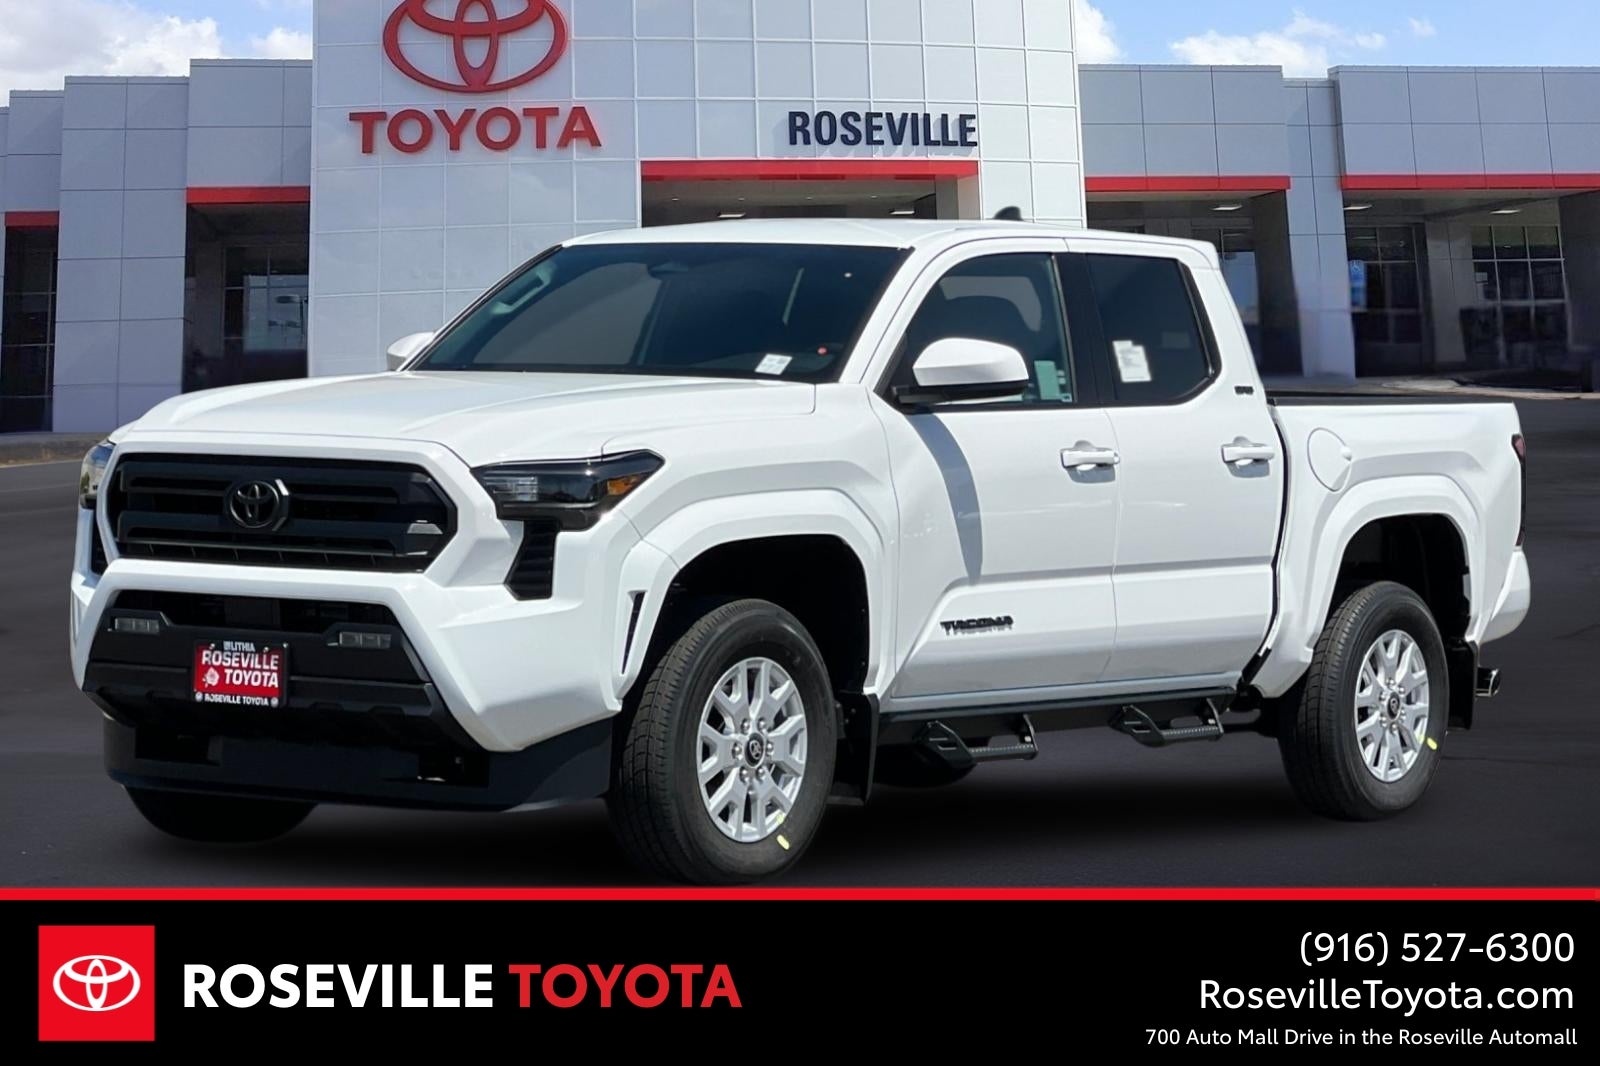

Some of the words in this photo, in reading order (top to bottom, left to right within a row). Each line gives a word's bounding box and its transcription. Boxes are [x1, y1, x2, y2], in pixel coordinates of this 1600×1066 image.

[350, 106, 601, 154] TOYOTA
[788, 111, 978, 147] ROSEVILLE
[230, 641, 256, 652] LITHIA
[202, 650, 279, 669] ROSEVILLE
[224, 668, 279, 688] TOYOTA
[204, 693, 241, 704] ROSEVILLE
[242, 695, 269, 706] TOYOTA
